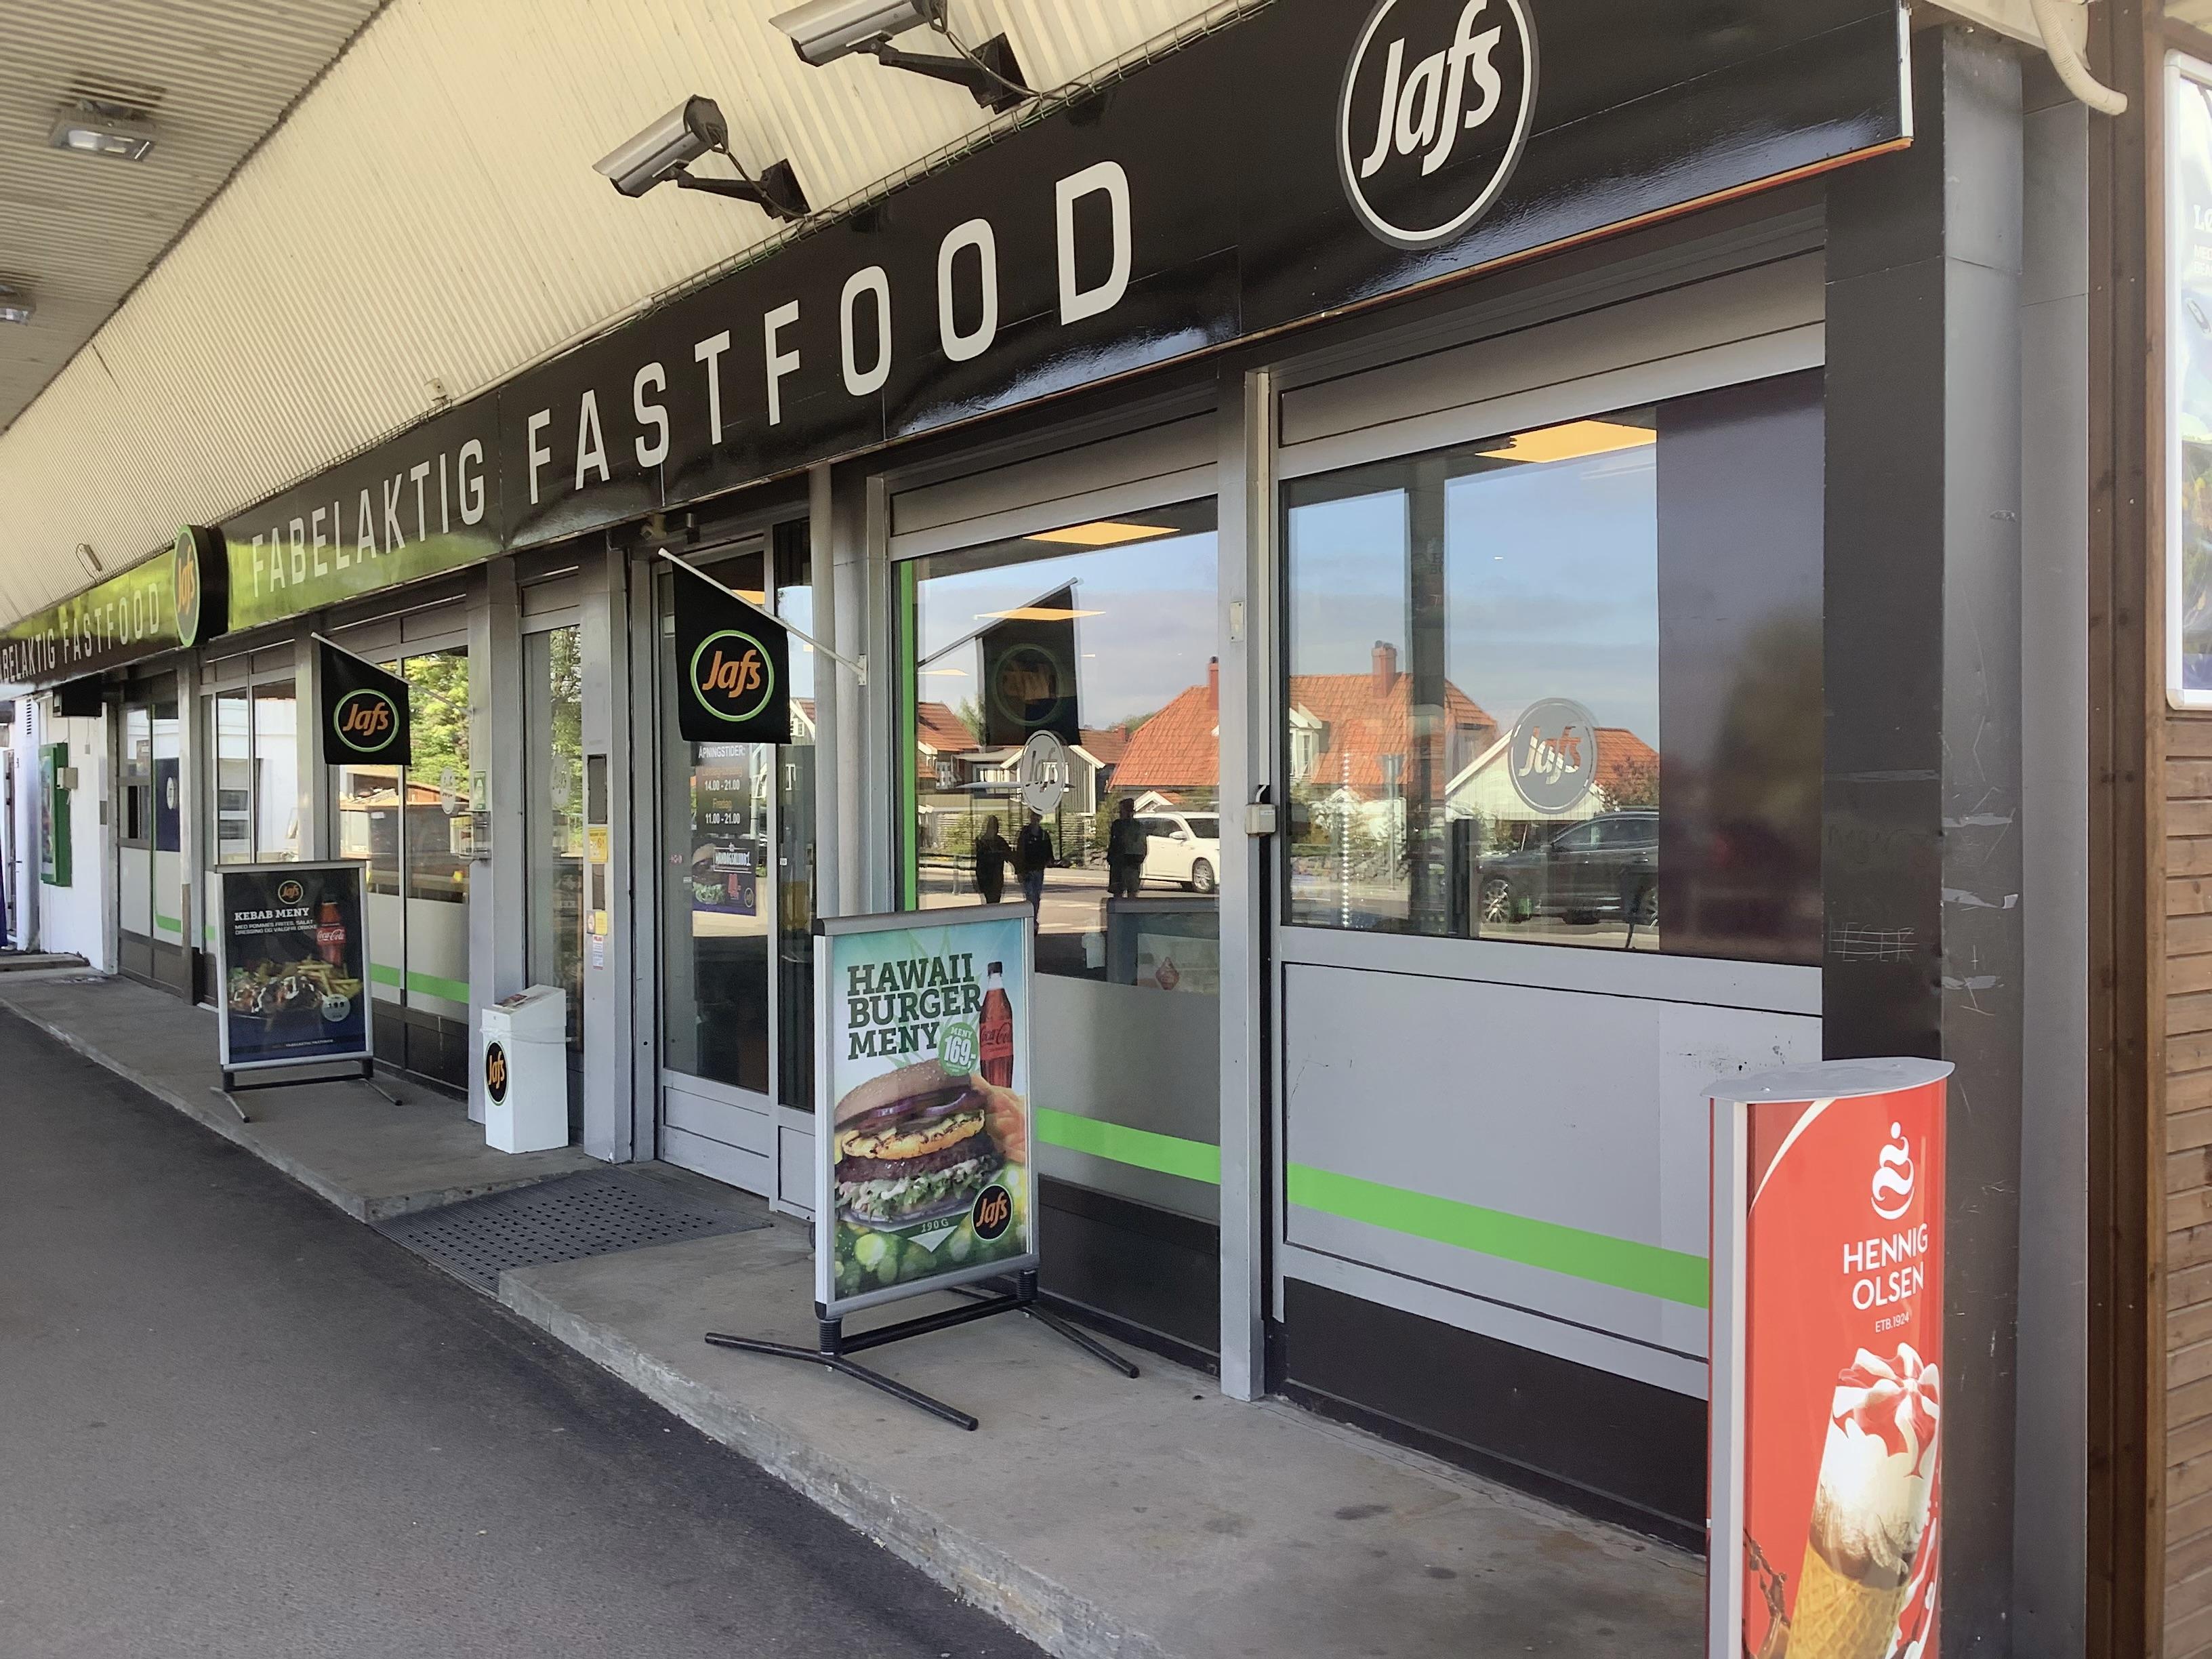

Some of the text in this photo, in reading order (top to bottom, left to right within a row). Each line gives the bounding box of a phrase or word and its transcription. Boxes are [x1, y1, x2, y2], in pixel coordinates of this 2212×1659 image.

[1360, 0, 1502, 179] Jafs
[251, 160, 1132, 598] FABELAKTIG FASTFOOD
[63, 582, 160, 664] FASTFOOD
[701, 649, 761, 698] Jafs
[342, 701, 389, 737] Jafs
[1518, 721, 1584, 785] Jafs
[705, 779, 720, 792] 14.00
[724, 779, 741, 791] 21.00
[705, 813, 720, 825] 11.00
[724, 813, 741, 825] 21.00
[281, 884, 300, 899] Jafs
[234, 907, 310, 922] KEBAB MENY
[316, 928, 346, 942] Coca-Cola
[847, 952, 975, 997] HAWAII
[847, 983, 982, 1029] BURGER
[847, 1021, 941, 1061] MENY
[943, 1036, 977, 1069] 169,-
[950, 1026, 973, 1039] MENY
[487, 1050, 505, 1090] Jafs
[921, 1218, 949, 1233] 190 G
[976, 1191, 1008, 1229] Jafs
[1843, 1222, 1929, 1275] HENNIG
[1852, 1261, 1925, 1310] OLSEN
